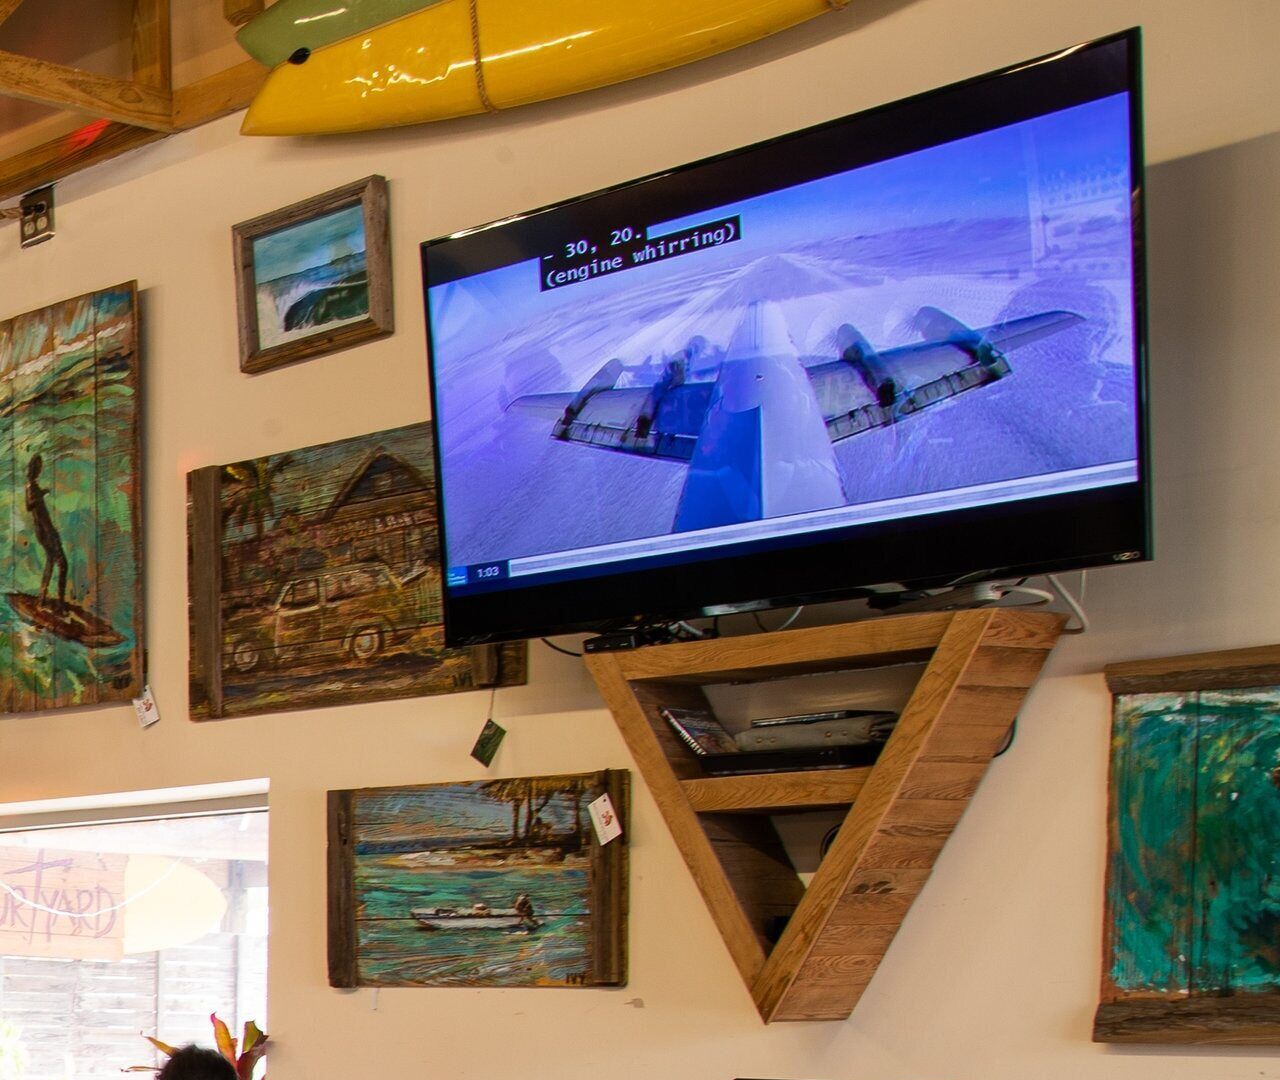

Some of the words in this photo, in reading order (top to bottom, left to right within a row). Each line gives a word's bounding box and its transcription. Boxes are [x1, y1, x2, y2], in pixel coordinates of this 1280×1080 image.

[546, 255, 623, 287] (engine
[633, 223, 735, 264] whirring)
[566, 240, 597, 257] 30,
[610, 227, 642, 246] 20.
